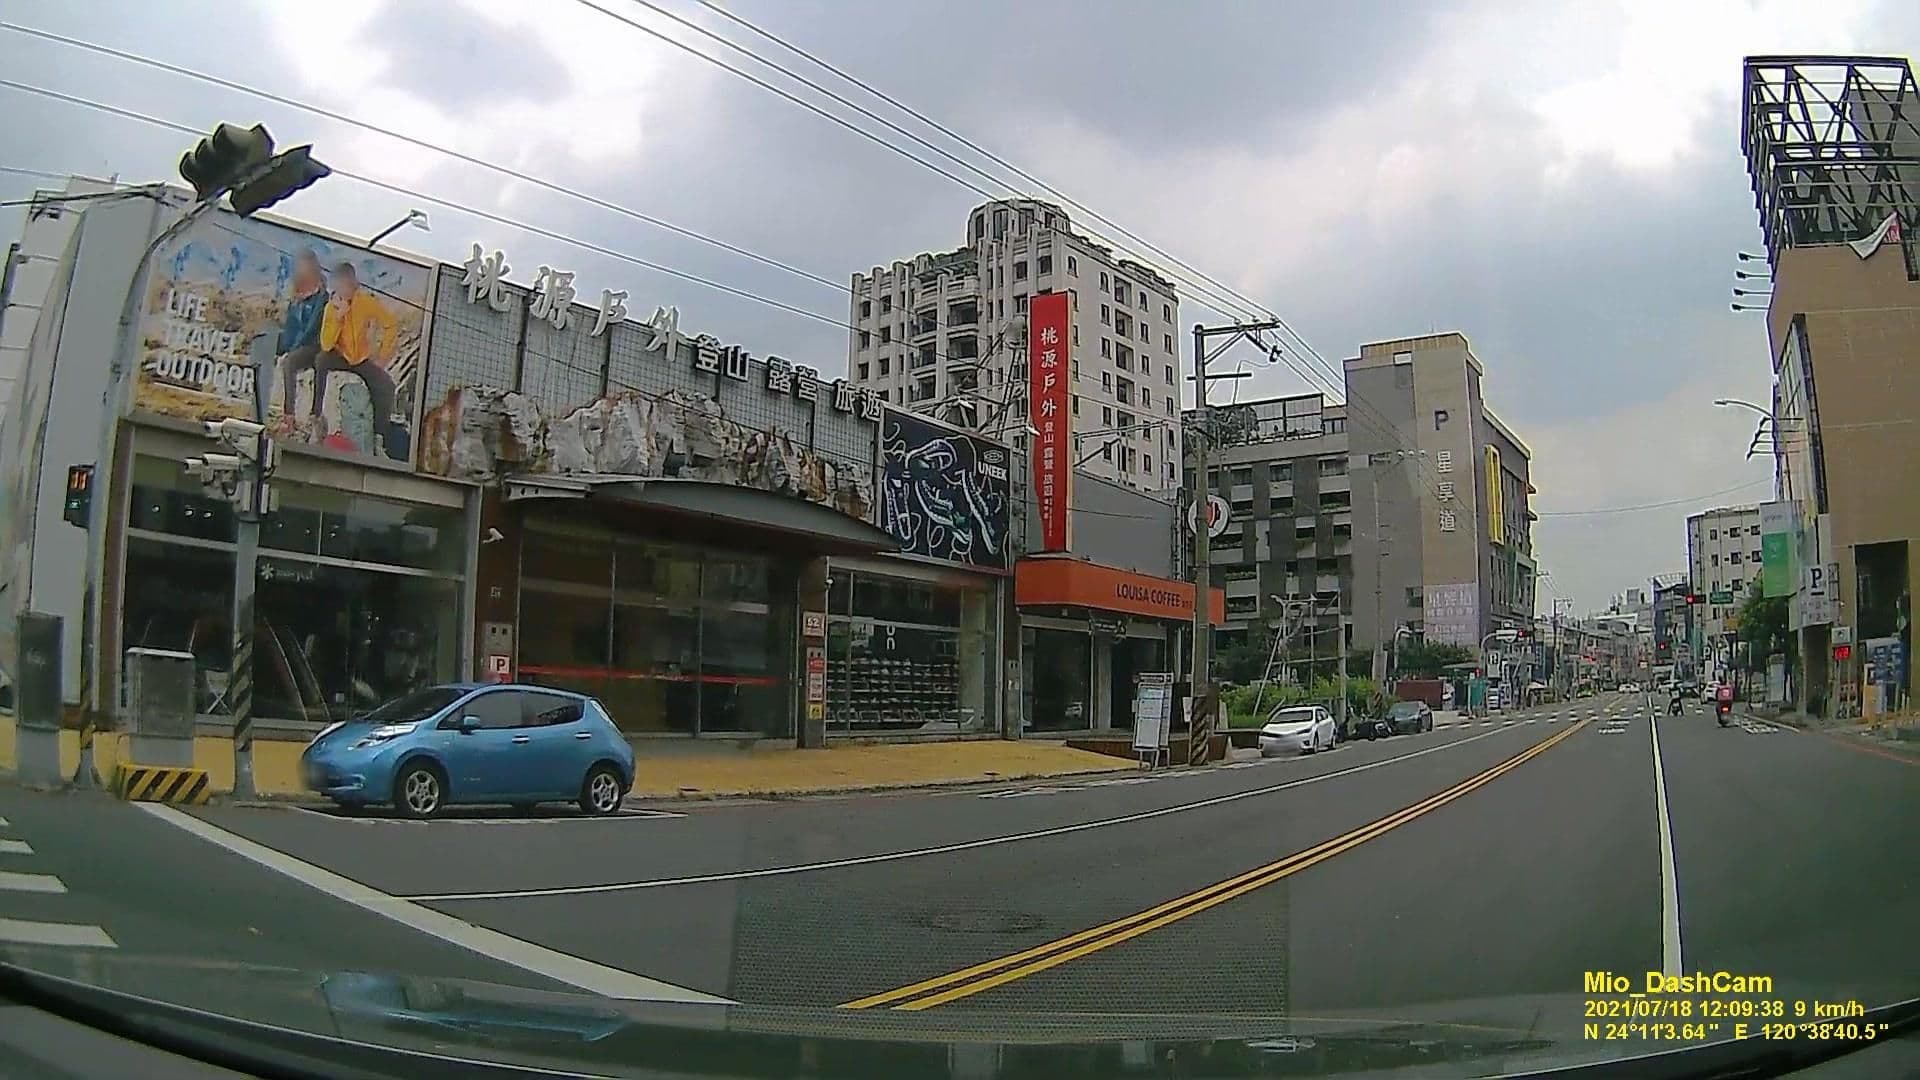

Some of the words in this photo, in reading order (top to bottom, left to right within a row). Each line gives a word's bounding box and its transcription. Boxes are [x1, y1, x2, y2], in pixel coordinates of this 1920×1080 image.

[167, 287, 209, 322] LIFE
[460, 241, 689, 363] 桃源戶外
[695, 333, 750, 383] 登山
[156, 357, 255, 395] OUTDOOR
[1040, 326, 1059, 418] 桃源戶外
[1434, 410, 1449, 431] P
[1437, 449, 1456, 533] 星享道
[1116, 583, 1151, 603] LOUISA
[1150, 588, 1181, 608] COFFEE
[1811, 568, 1824, 589] P
[496, 658, 506, 672] P
